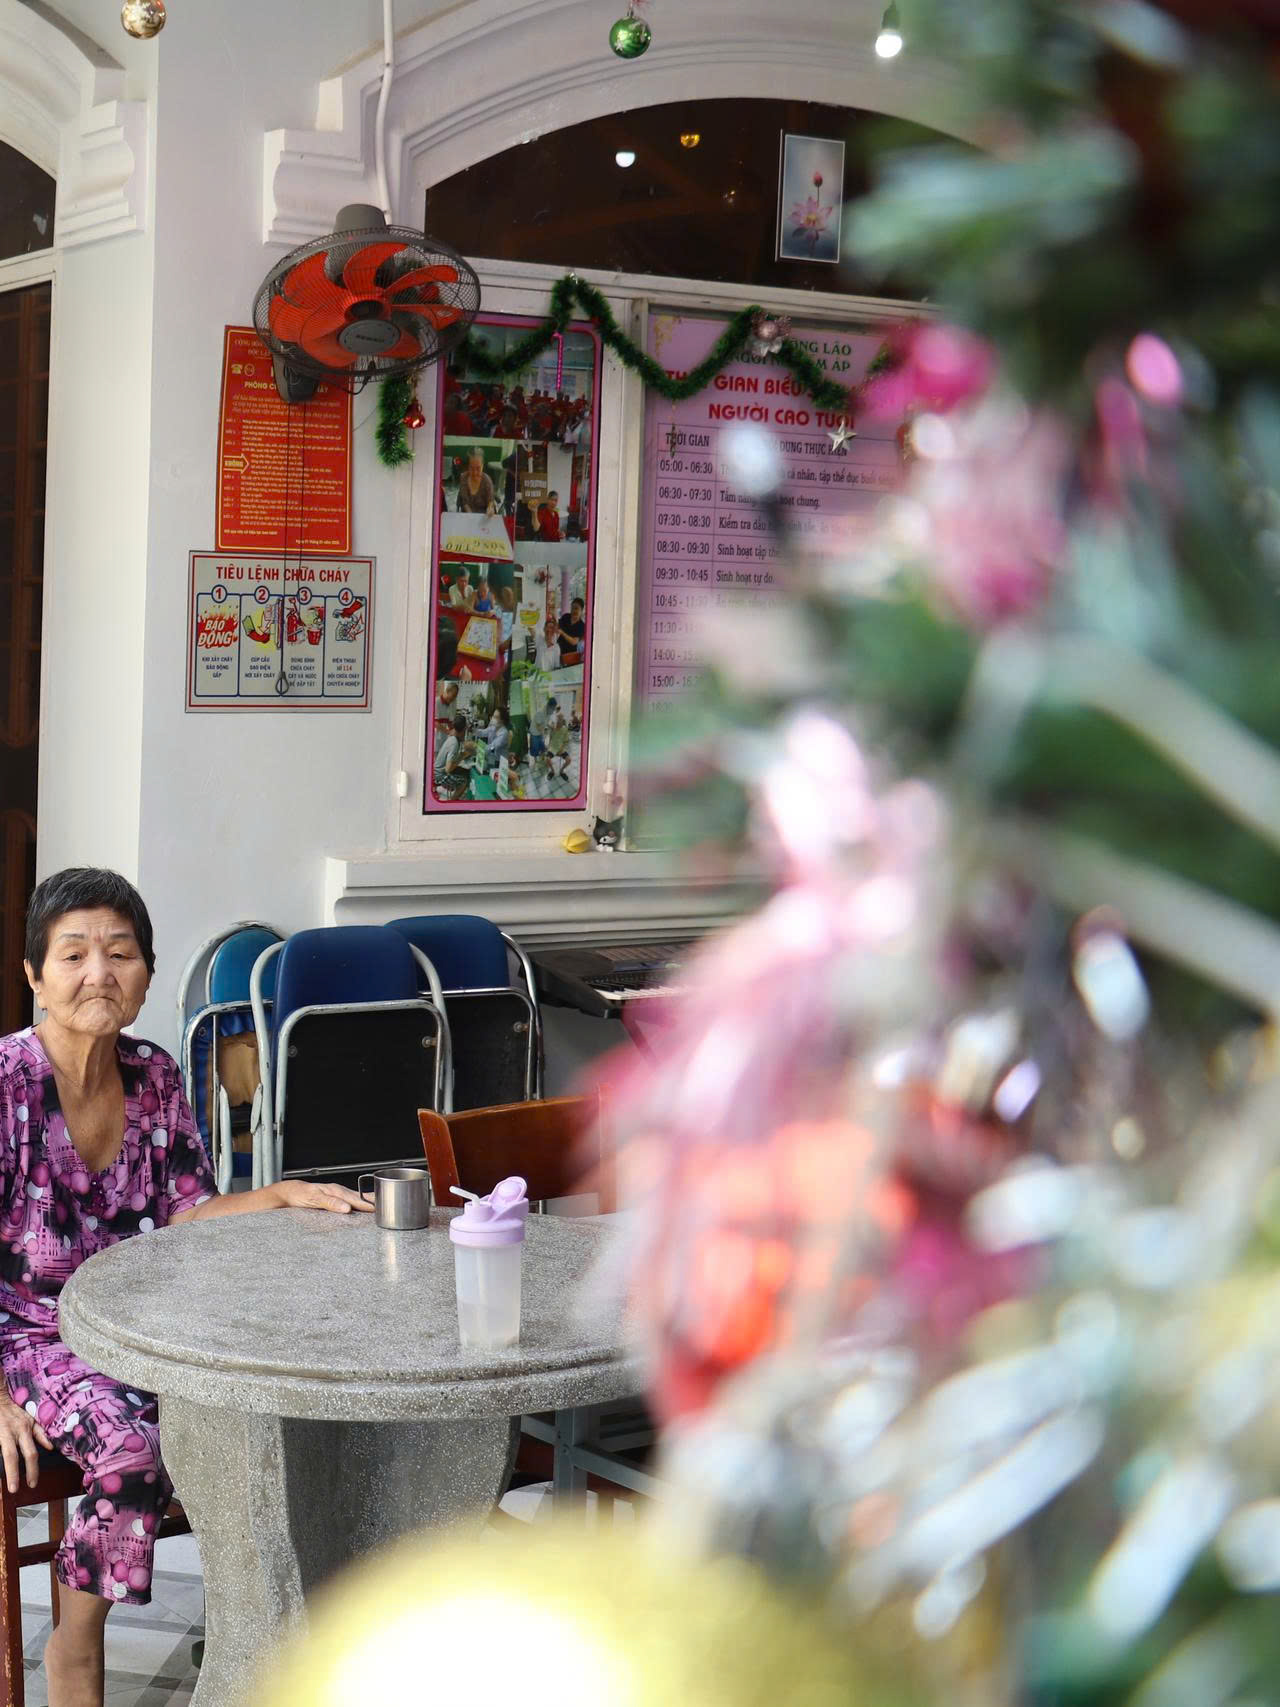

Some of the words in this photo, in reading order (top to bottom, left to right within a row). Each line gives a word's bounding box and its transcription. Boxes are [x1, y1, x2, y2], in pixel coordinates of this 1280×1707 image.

[823, 340, 852, 355] LÃO
[832, 358, 850, 372] ÁP
[714, 375, 758, 392] GIAN
[764, 373, 802, 397] BIỂU
[708, 402, 769, 423] NGƯỜI
[774, 409, 810, 426] CAO
[689, 433, 710, 447] GIAN
[805, 442, 826, 457] THỰC
[659, 459, 683, 472] 05:00
[690, 461, 713, 474] 06:30
[689, 488, 712, 501] 07:30
[658, 513, 681, 526] 07:30
[688, 515, 711, 528] 08:30
[718, 513, 739, 529] Kiểm
[740, 520, 751, 530] tra
[657, 540, 680, 553] 08:30
[687, 542, 710, 554] 09:30
[717, 543, 734, 556] Sinh
[736, 545, 752, 559] hoạt
[216, 564, 244, 580] TIÊU
[248, 564, 279, 583] LỆNH
[283, 566, 316, 582] CHỮA
[319, 567, 351, 583] CHÁY
[656, 568, 679, 580] 09:30
[687, 569, 708, 581] 10:45
[716, 570, 733, 583] Sinh
[736, 572, 752, 586] hoạt
[216, 588, 222, 599] 1
[258, 589, 266, 601] 2
[300, 590, 308, 601] 3
[341, 591, 350, 602] 4
[656, 594, 678, 607] 10:45
[204, 618, 225, 631] BÁO
[198, 631, 233, 649] ĐỘNG
[652, 675, 674, 687] 15:00
